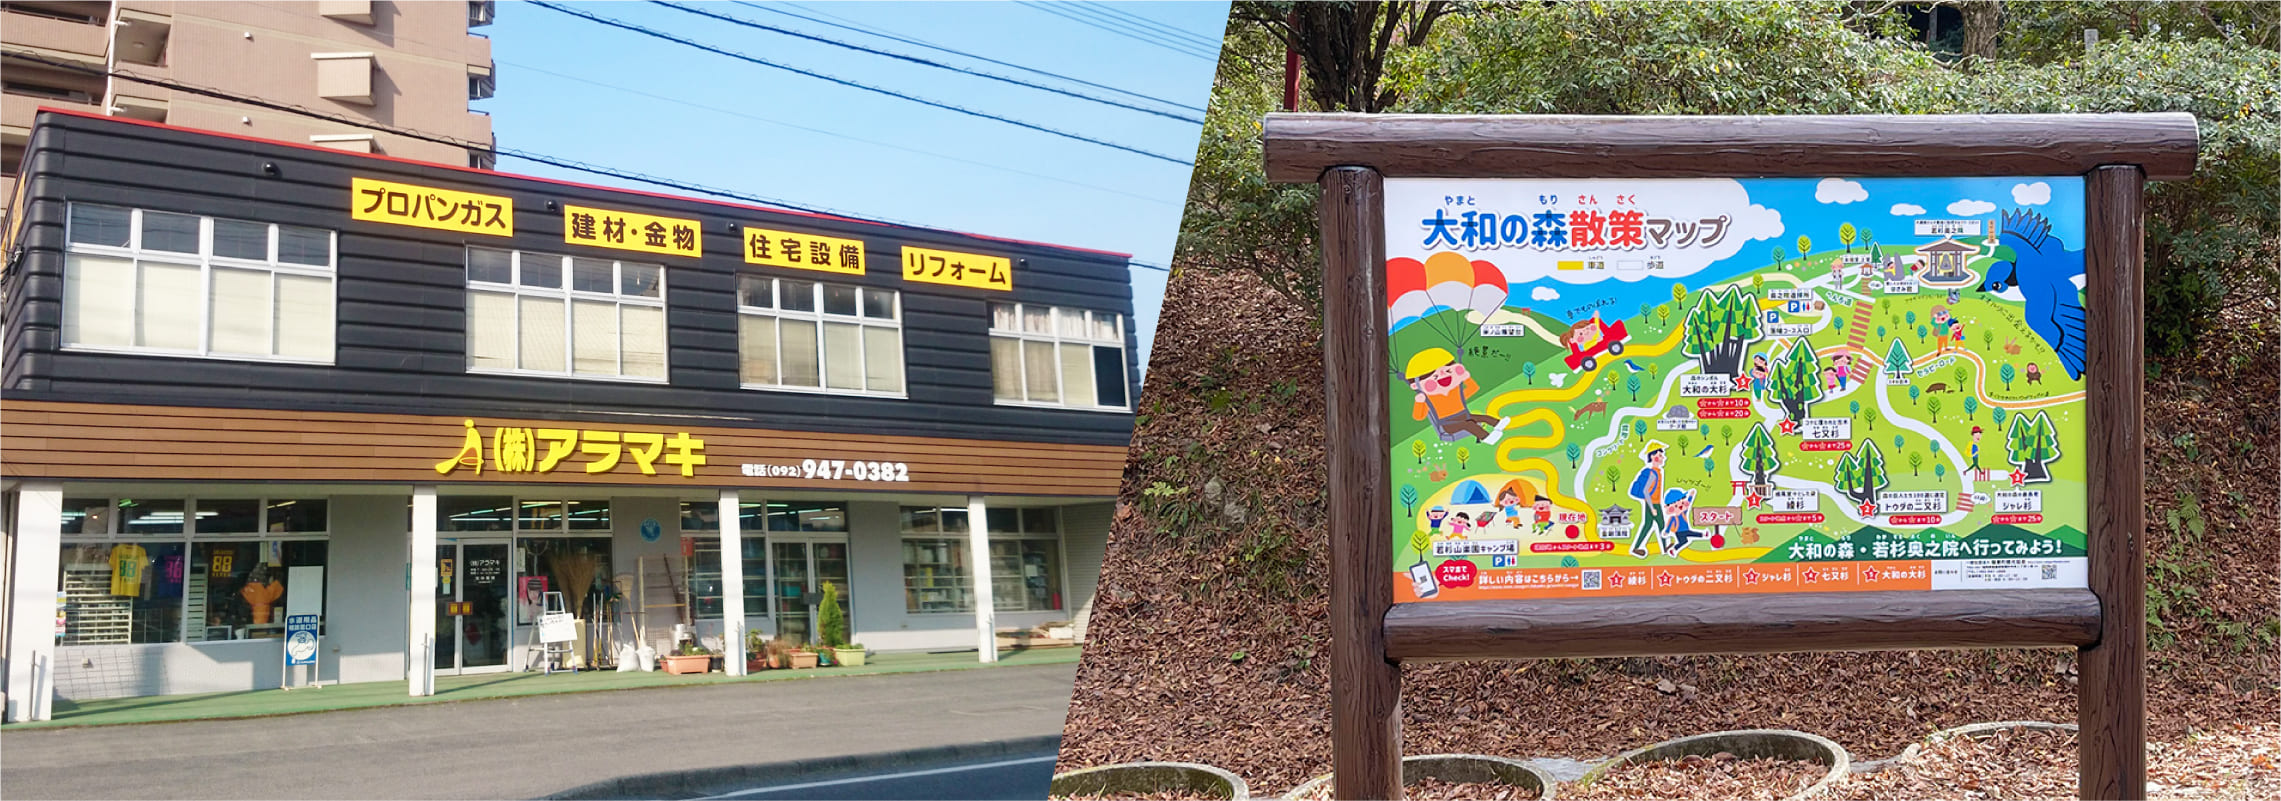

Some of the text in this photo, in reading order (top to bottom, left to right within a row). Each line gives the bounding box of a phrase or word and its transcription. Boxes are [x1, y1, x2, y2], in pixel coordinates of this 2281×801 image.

[1445, 195, 1476, 205] やまと
[1539, 194, 1558, 205] もり
[1578, 194, 1598, 205] さん
[1616, 194, 1635, 205] さく
[361, 187, 506, 229] プロパンガス
[571, 212, 695, 252] 建材・金物
[1421, 208, 1728, 248] 大和の森散策マップ
[749, 233, 860, 270] 住宅設備
[909, 252, 1006, 284] リフォーム
[1682, 385, 1727, 394] 大和の大杉
[1812, 429, 1839, 439] 七又杉
[493, 425, 708, 477] (株)アラマキ
[1559, 513, 1586, 522] 現在地
[1700, 512, 1733, 522] スタート
[1442, 565, 1467, 573] スマホで
[1443, 573, 1470, 582] Check!
[1821, 571, 1849, 581] 七又杉
[1881, 570, 1926, 580] 大和の大杉
